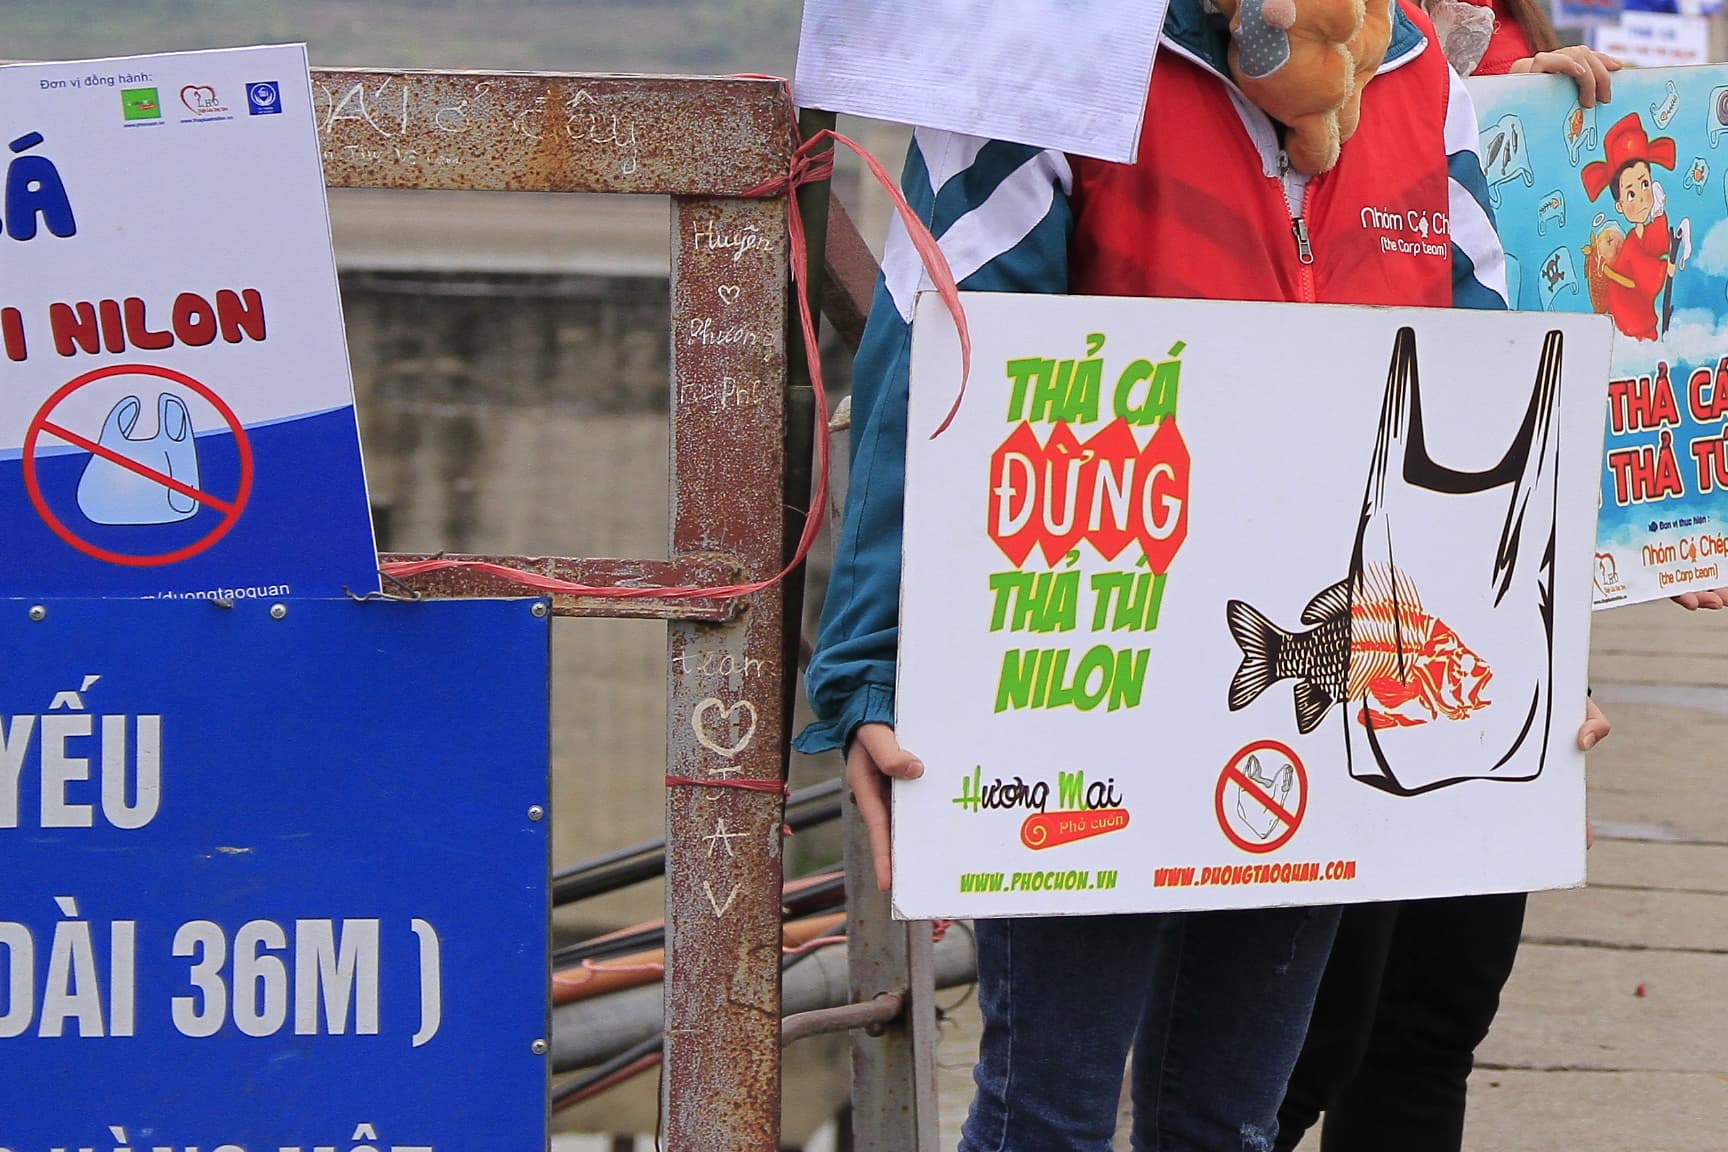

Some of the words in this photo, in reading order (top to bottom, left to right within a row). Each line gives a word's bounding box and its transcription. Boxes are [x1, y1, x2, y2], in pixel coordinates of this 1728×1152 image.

[0, 131, 77, 241] Á
[1361, 206, 1403, 231] Nhóm
[50, 288, 267, 357] NILON
[1006, 332, 1105, 424] THẢ
[1113, 340, 1187, 426] CÁ
[1609, 361, 1679, 432] THẢ
[994, 442, 1183, 541] ĐỪNG
[1608, 431, 1684, 505] THẢ
[1642, 542, 1677, 567] Nhóm
[989, 550, 1082, 634] THẢ
[1090, 554, 1168, 634] TÚI
[994, 644, 1151, 714] NILON
[952, 765, 1050, 814] Hương
[1058, 770, 1123, 811] Mai
[960, 870, 1118, 894] WWW.PHOCUON.VN
[1153, 860, 1357, 888] WWW.DUONGTAOQUAN.COM
[171, 918, 380, 1038] 36M
